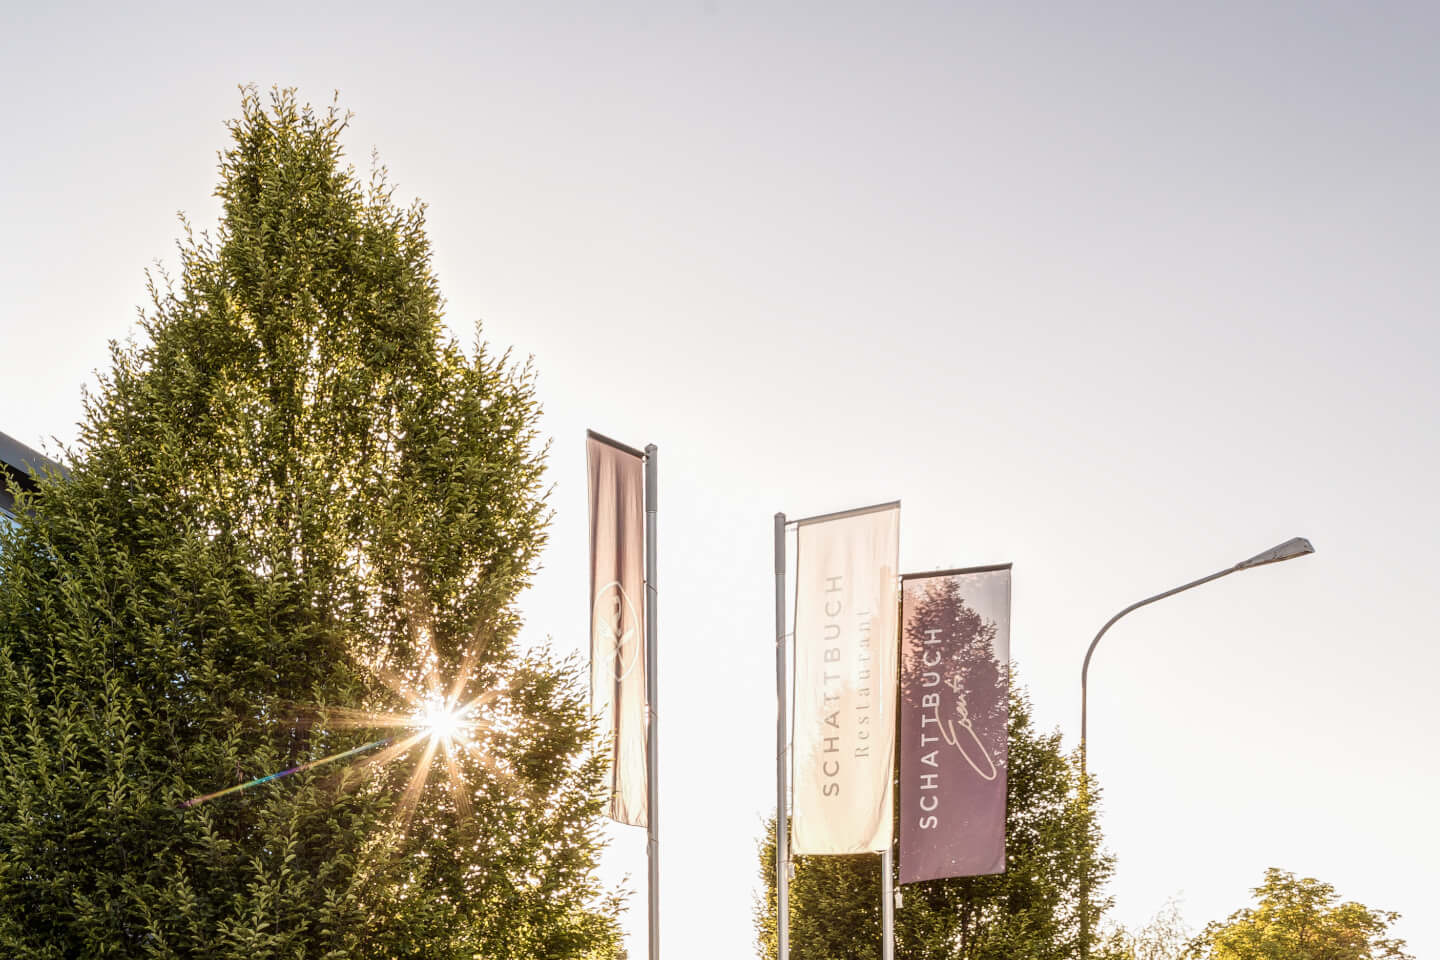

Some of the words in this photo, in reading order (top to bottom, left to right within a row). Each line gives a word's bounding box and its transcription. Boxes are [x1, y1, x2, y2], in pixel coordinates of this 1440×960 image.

[822, 574, 843, 798] SCHATTBUCH
[854, 611, 872, 760] Restaurant
[919, 626, 943, 830] SCHATTBUCH
